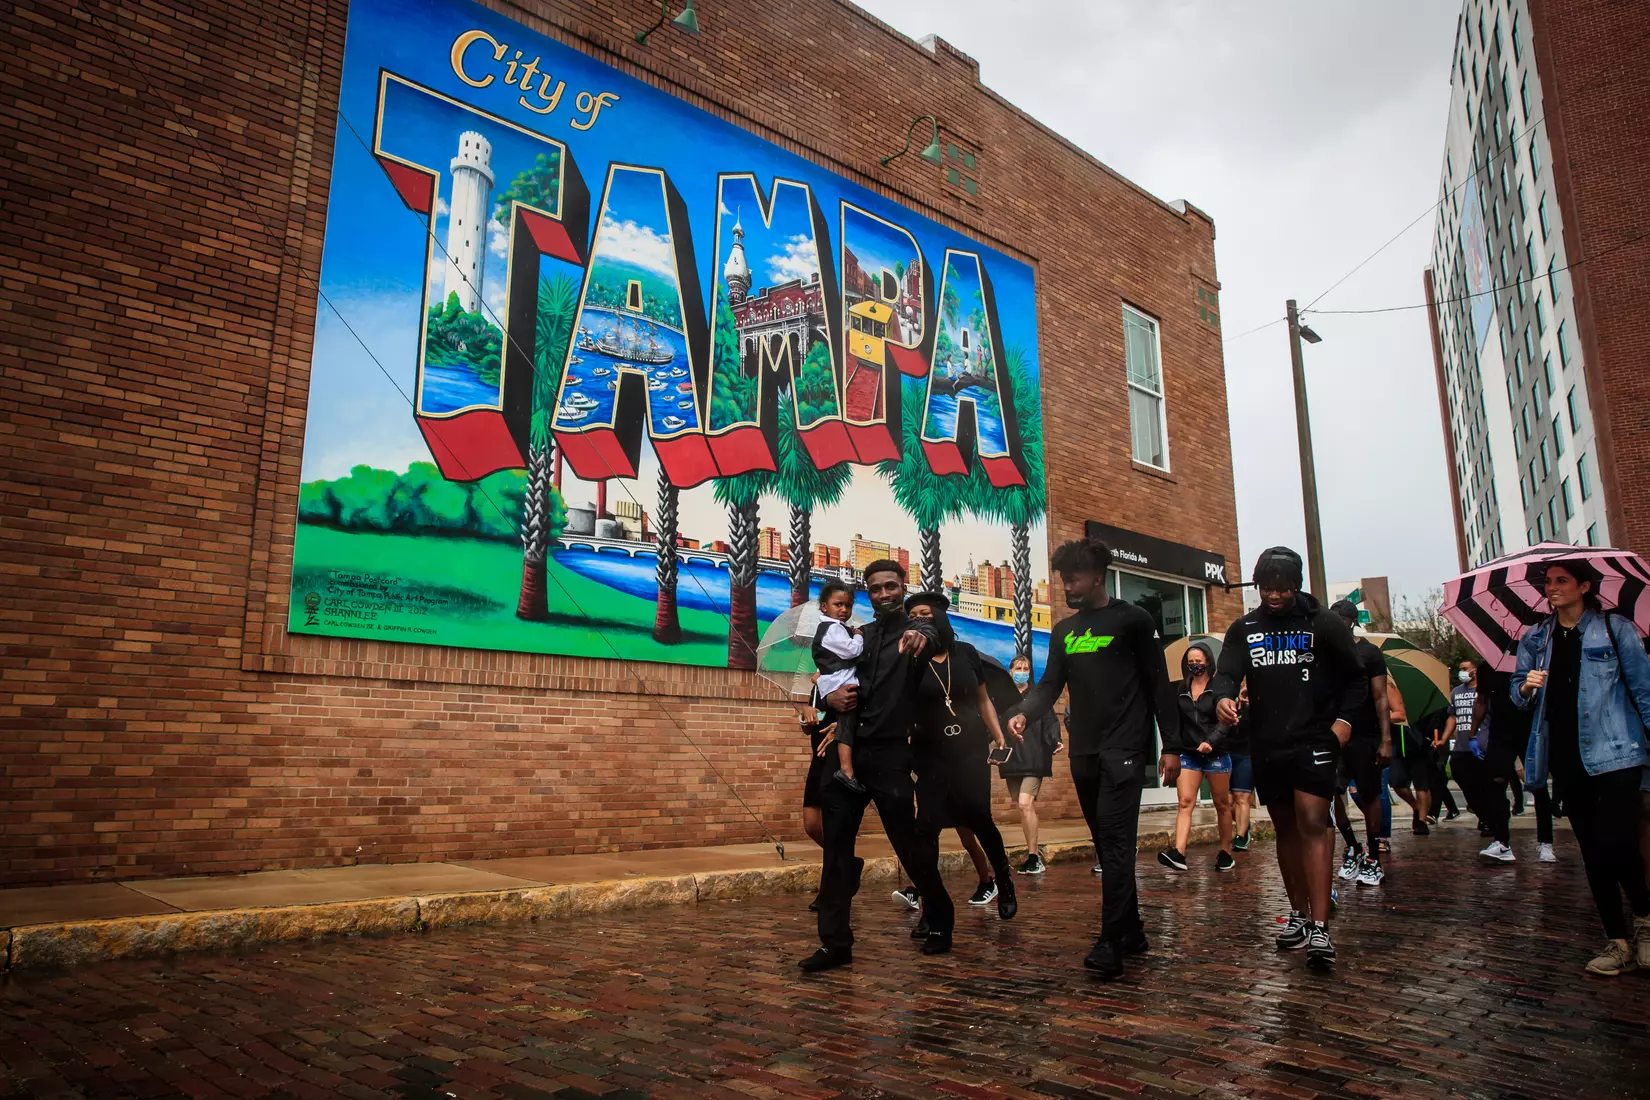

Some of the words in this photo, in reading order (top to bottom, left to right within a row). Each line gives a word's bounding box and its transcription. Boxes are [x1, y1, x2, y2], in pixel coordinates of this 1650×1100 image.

[450, 29, 566, 115] City
[569, 91, 620, 132] of
[373, 67, 1027, 487] TAMPA
[1110, 548, 1119, 557] rth
[1119, 549, 1137, 561] Florida
[1138, 554, 1148, 564] Ave
[1204, 561, 1226, 584] PPK
[328, 586, 344, 597] City
[420, 596, 449, 606] Program
[324, 598, 351, 609] CARL
[351, 601, 391, 614] COWDEN
[408, 606, 428, 616] 2012
[323, 619, 339, 627] CARL
[339, 621, 366, 629] COWDEN
[383, 625, 406, 633] GRIFFIN
[1064, 628, 1115, 654] USF
[1247, 632, 1267, 667] 2018
[1301, 668, 1309, 681] 3
